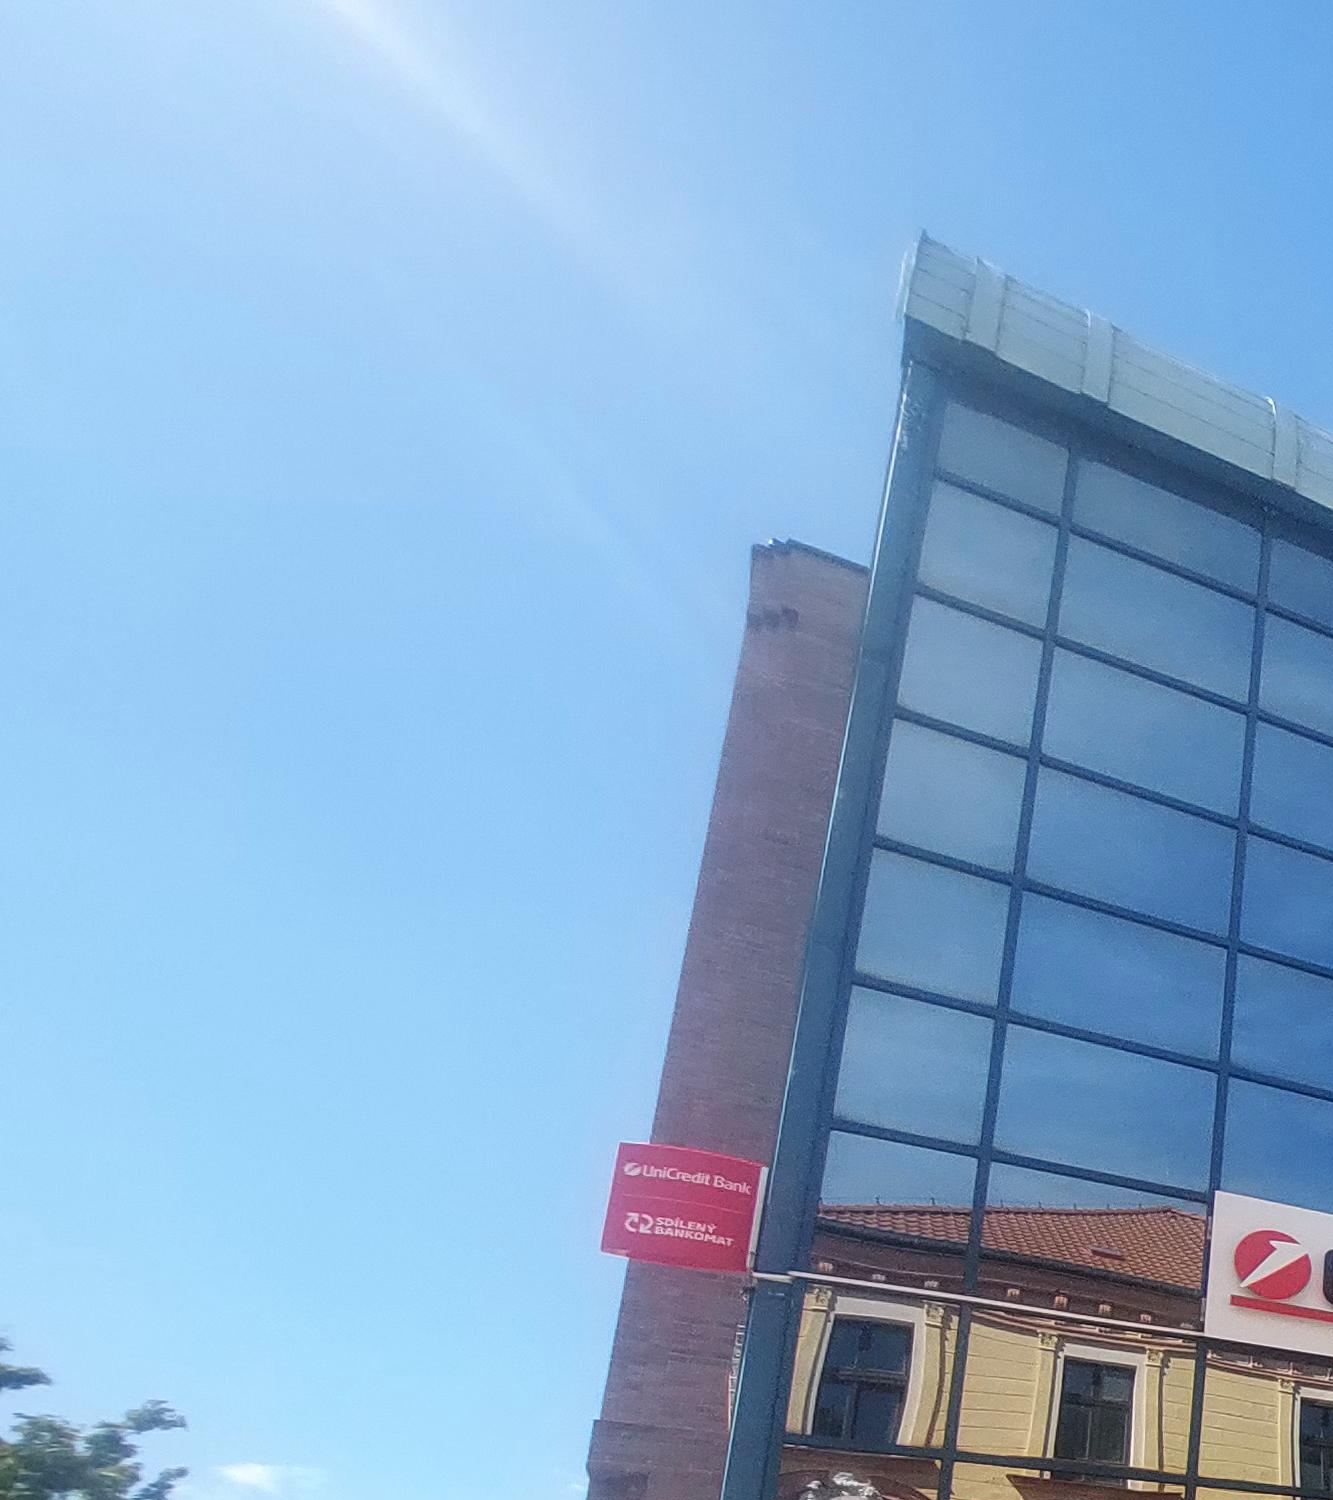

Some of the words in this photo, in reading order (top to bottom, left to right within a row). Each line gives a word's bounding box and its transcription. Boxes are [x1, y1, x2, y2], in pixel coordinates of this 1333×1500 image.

[643, 1164, 711, 1187] UniCredit
[713, 1175, 752, 1196] Bank
[655, 1216, 717, 1234] SDÍLENÝ
[655, 1226, 734, 1247] BANKOMAT
